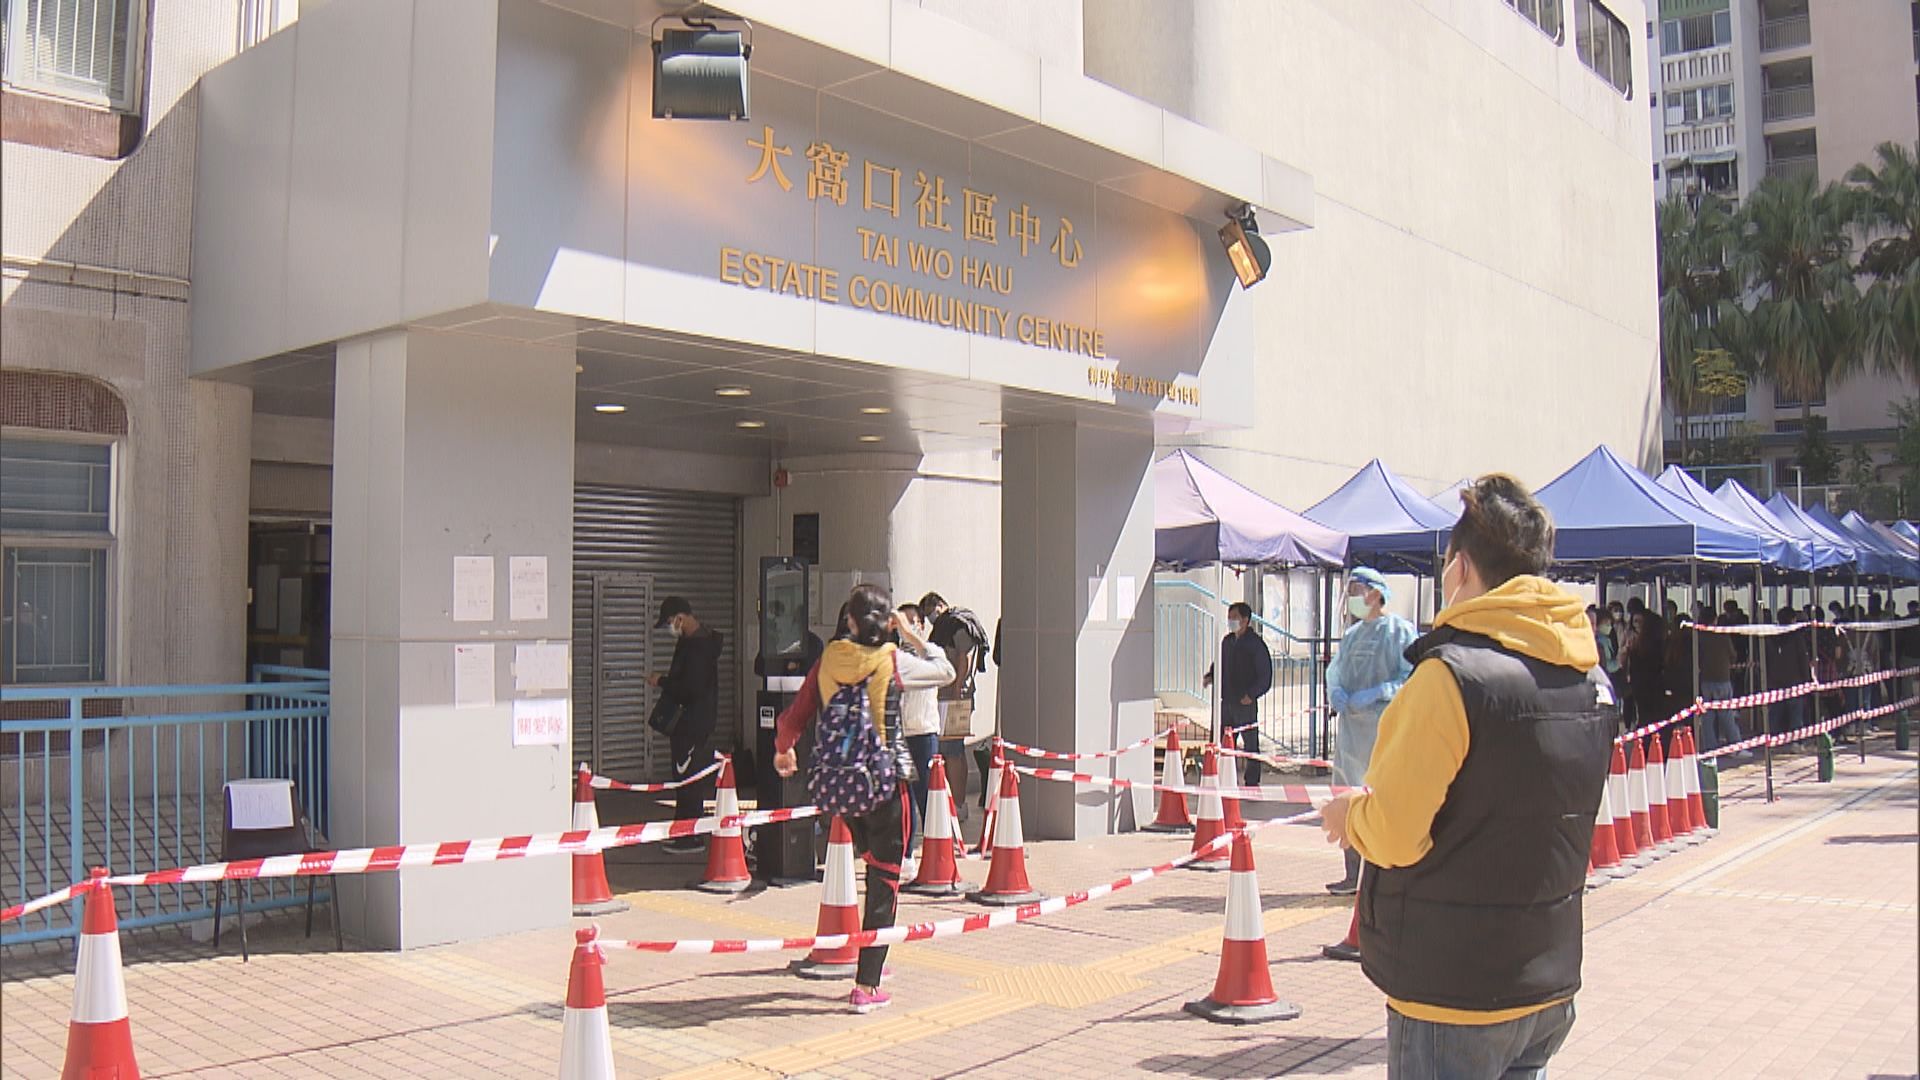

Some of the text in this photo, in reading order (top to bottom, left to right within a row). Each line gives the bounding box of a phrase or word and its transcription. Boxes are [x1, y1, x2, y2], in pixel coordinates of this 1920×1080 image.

[746, 125, 1083, 269] 大窩口社區中心
[720, 246, 1107, 359] ESTATE COMMUNITY CENTRE
[857, 226, 1013, 295] TAI WO HAU
